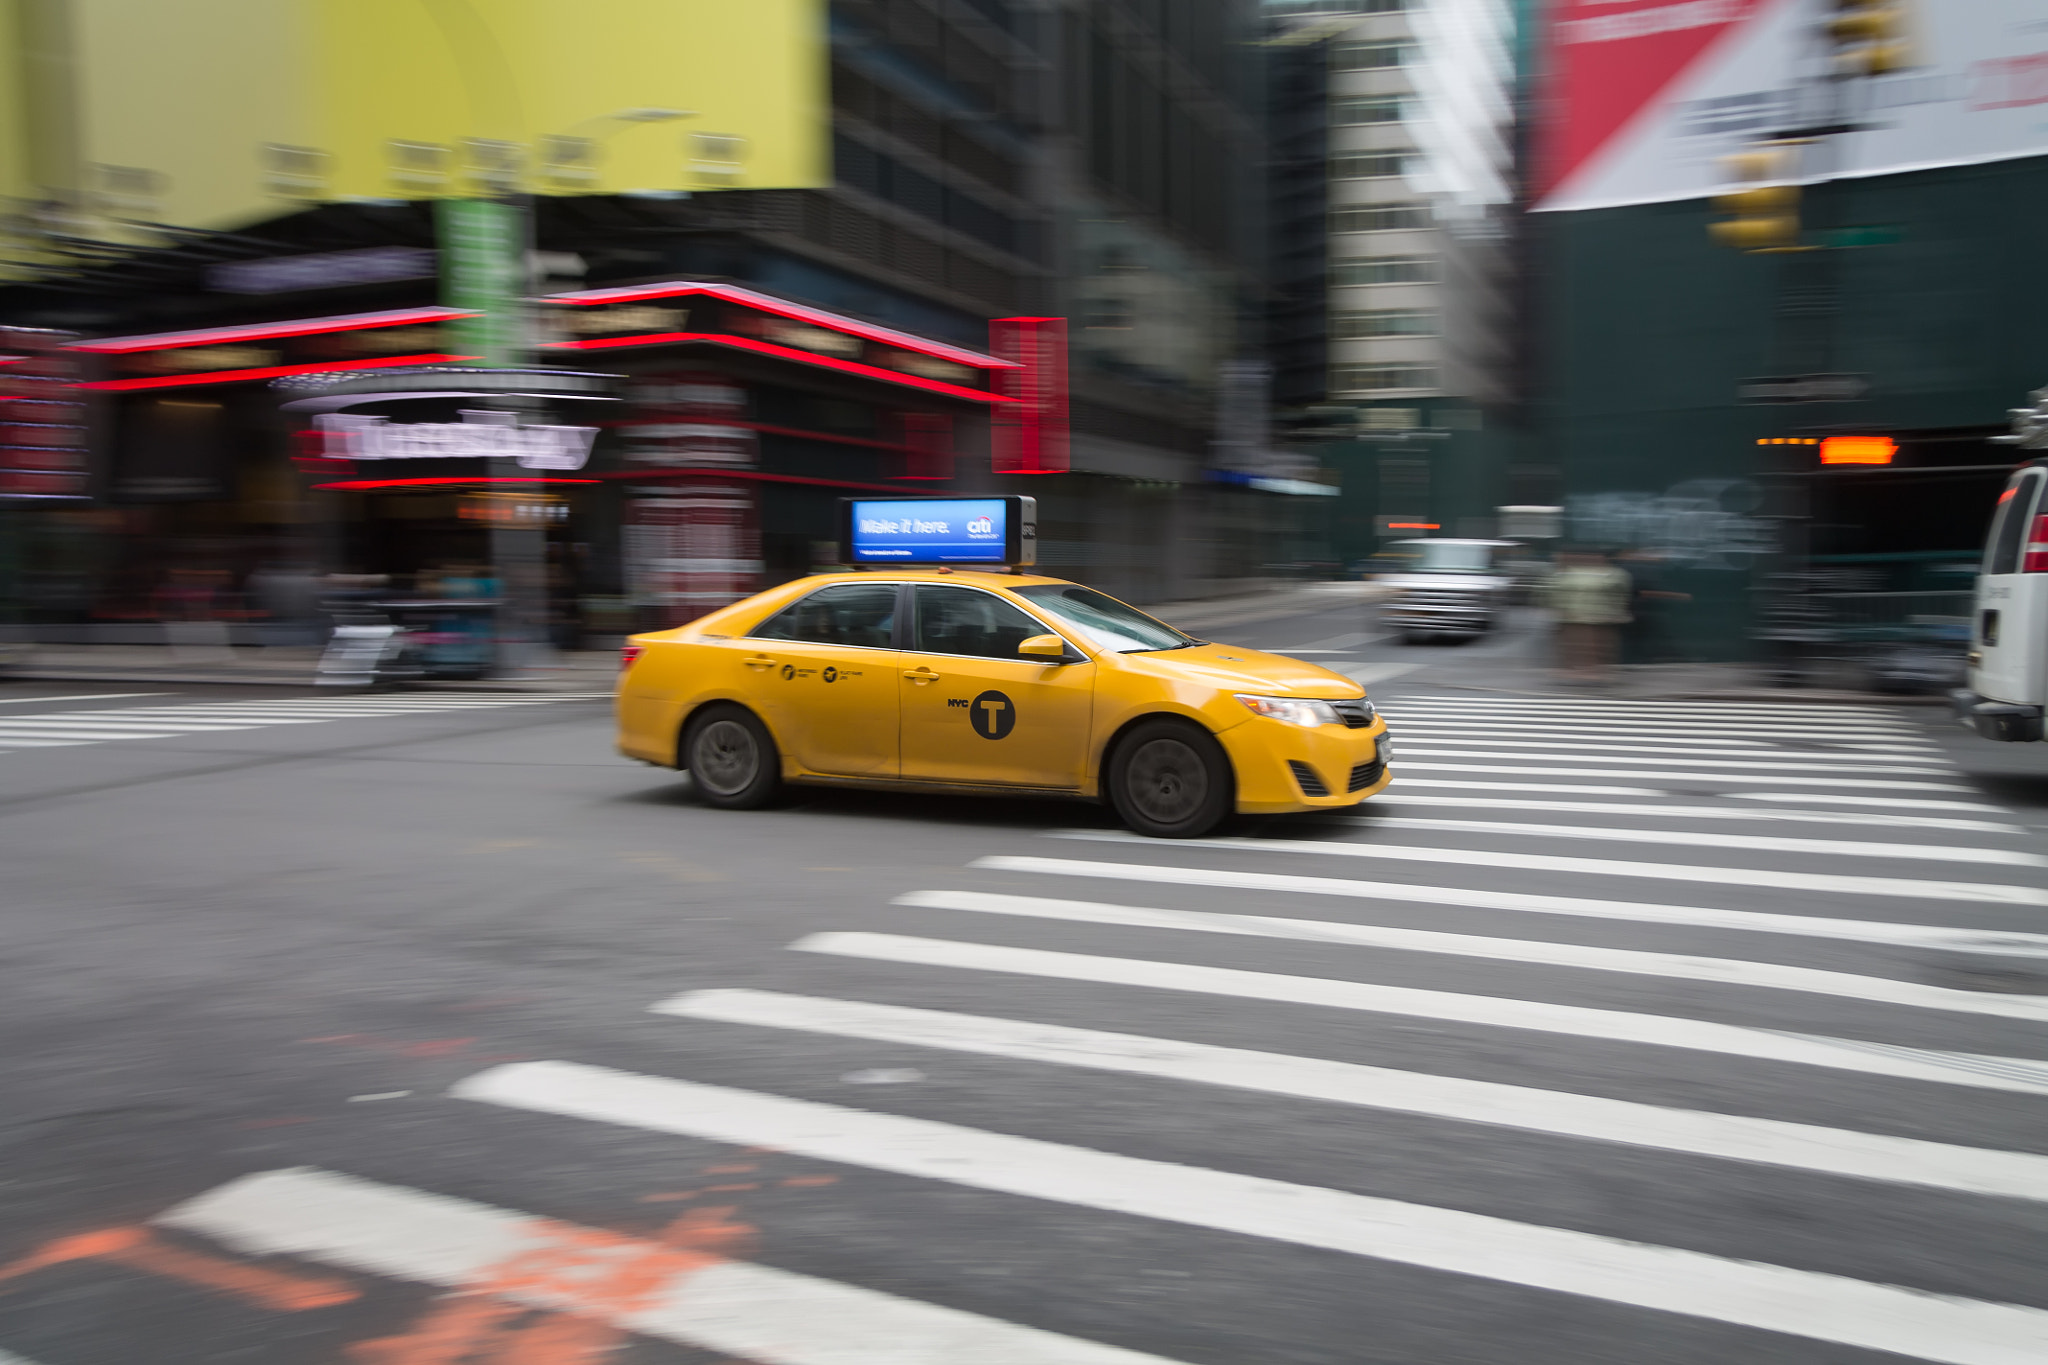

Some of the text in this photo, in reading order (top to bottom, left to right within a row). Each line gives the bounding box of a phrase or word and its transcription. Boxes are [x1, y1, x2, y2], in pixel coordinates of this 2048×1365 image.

[859, 519, 898, 534] Make
[899, 518, 912, 534] it
[966, 517, 992, 534] citi
[947, 699, 1006, 734] NYC T
